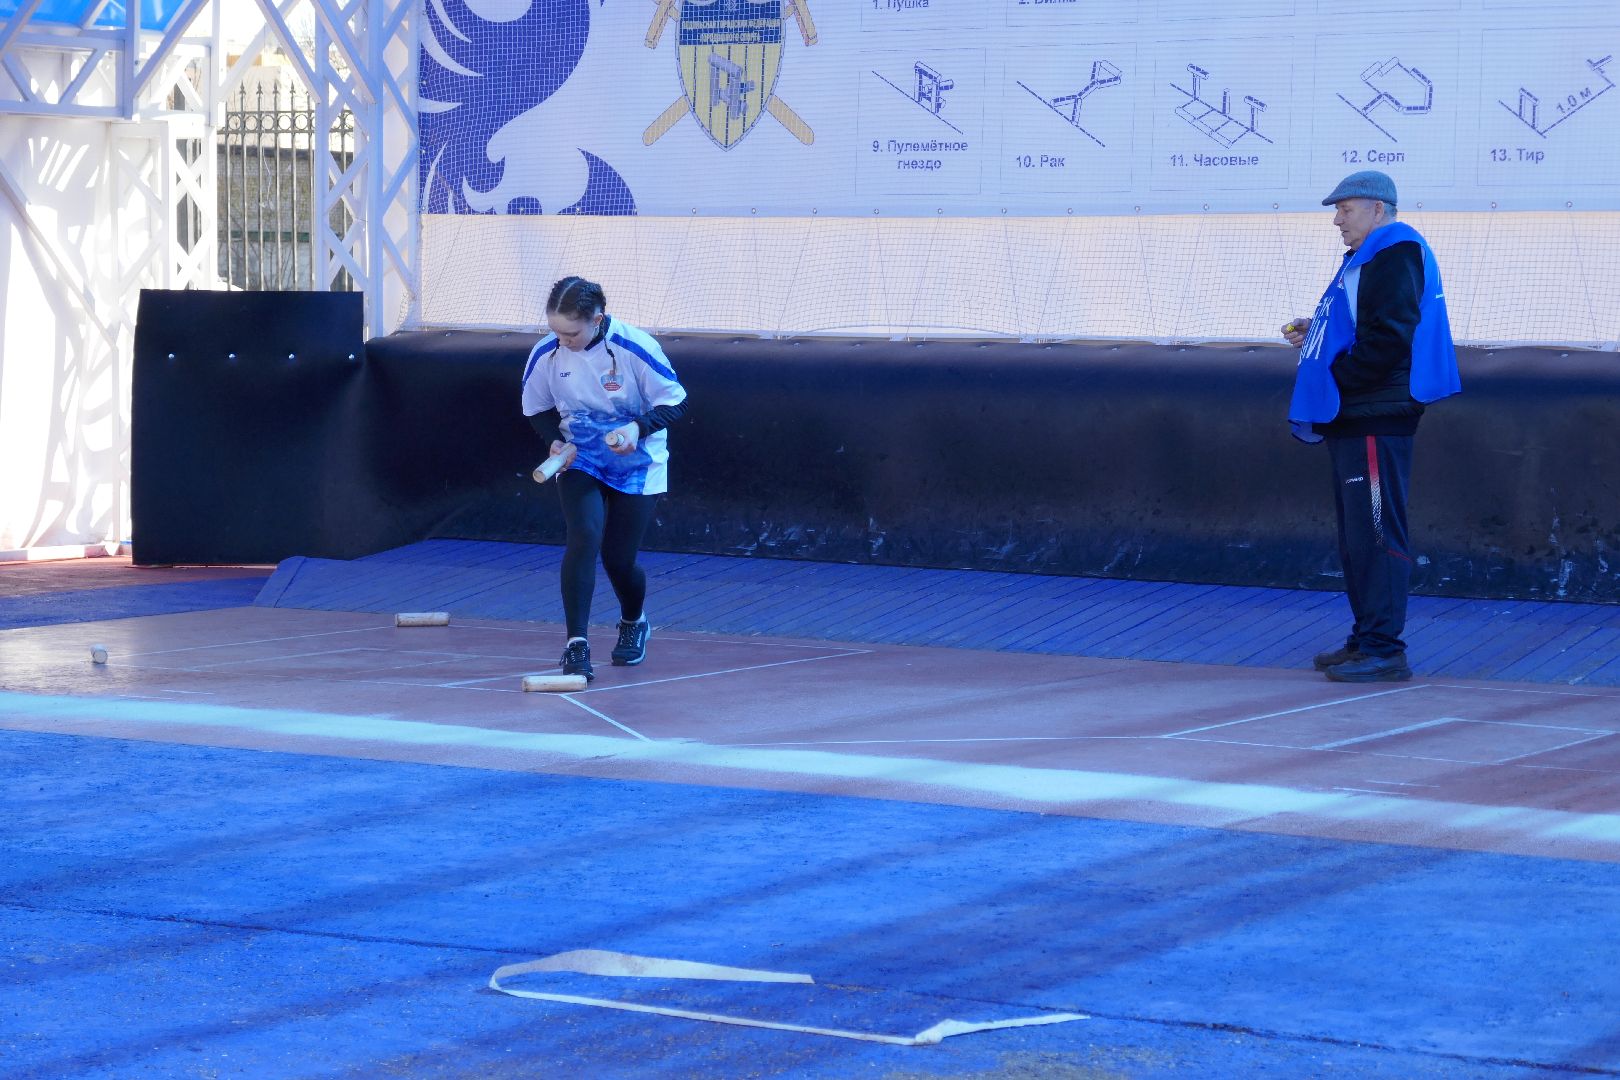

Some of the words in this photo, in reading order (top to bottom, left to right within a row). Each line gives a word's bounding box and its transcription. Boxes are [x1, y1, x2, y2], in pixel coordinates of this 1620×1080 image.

[1556, 94, 1578, 114] 1.0
[872, 140, 883, 152] 9.
[887, 139, 969, 155] Пулемётное
[1016, 155, 1035, 168] 10.
[1040, 154, 1065, 168] Рак
[1170, 154, 1188, 167] 11.
[1193, 153, 1259, 167] Часовые
[1341, 150, 1362, 163] 12.
[1367, 150, 1405, 165] Серп
[1490, 148, 1512, 162] 13.
[1516, 148, 1545, 164] Тир
[897, 158, 942, 171] гнездо
